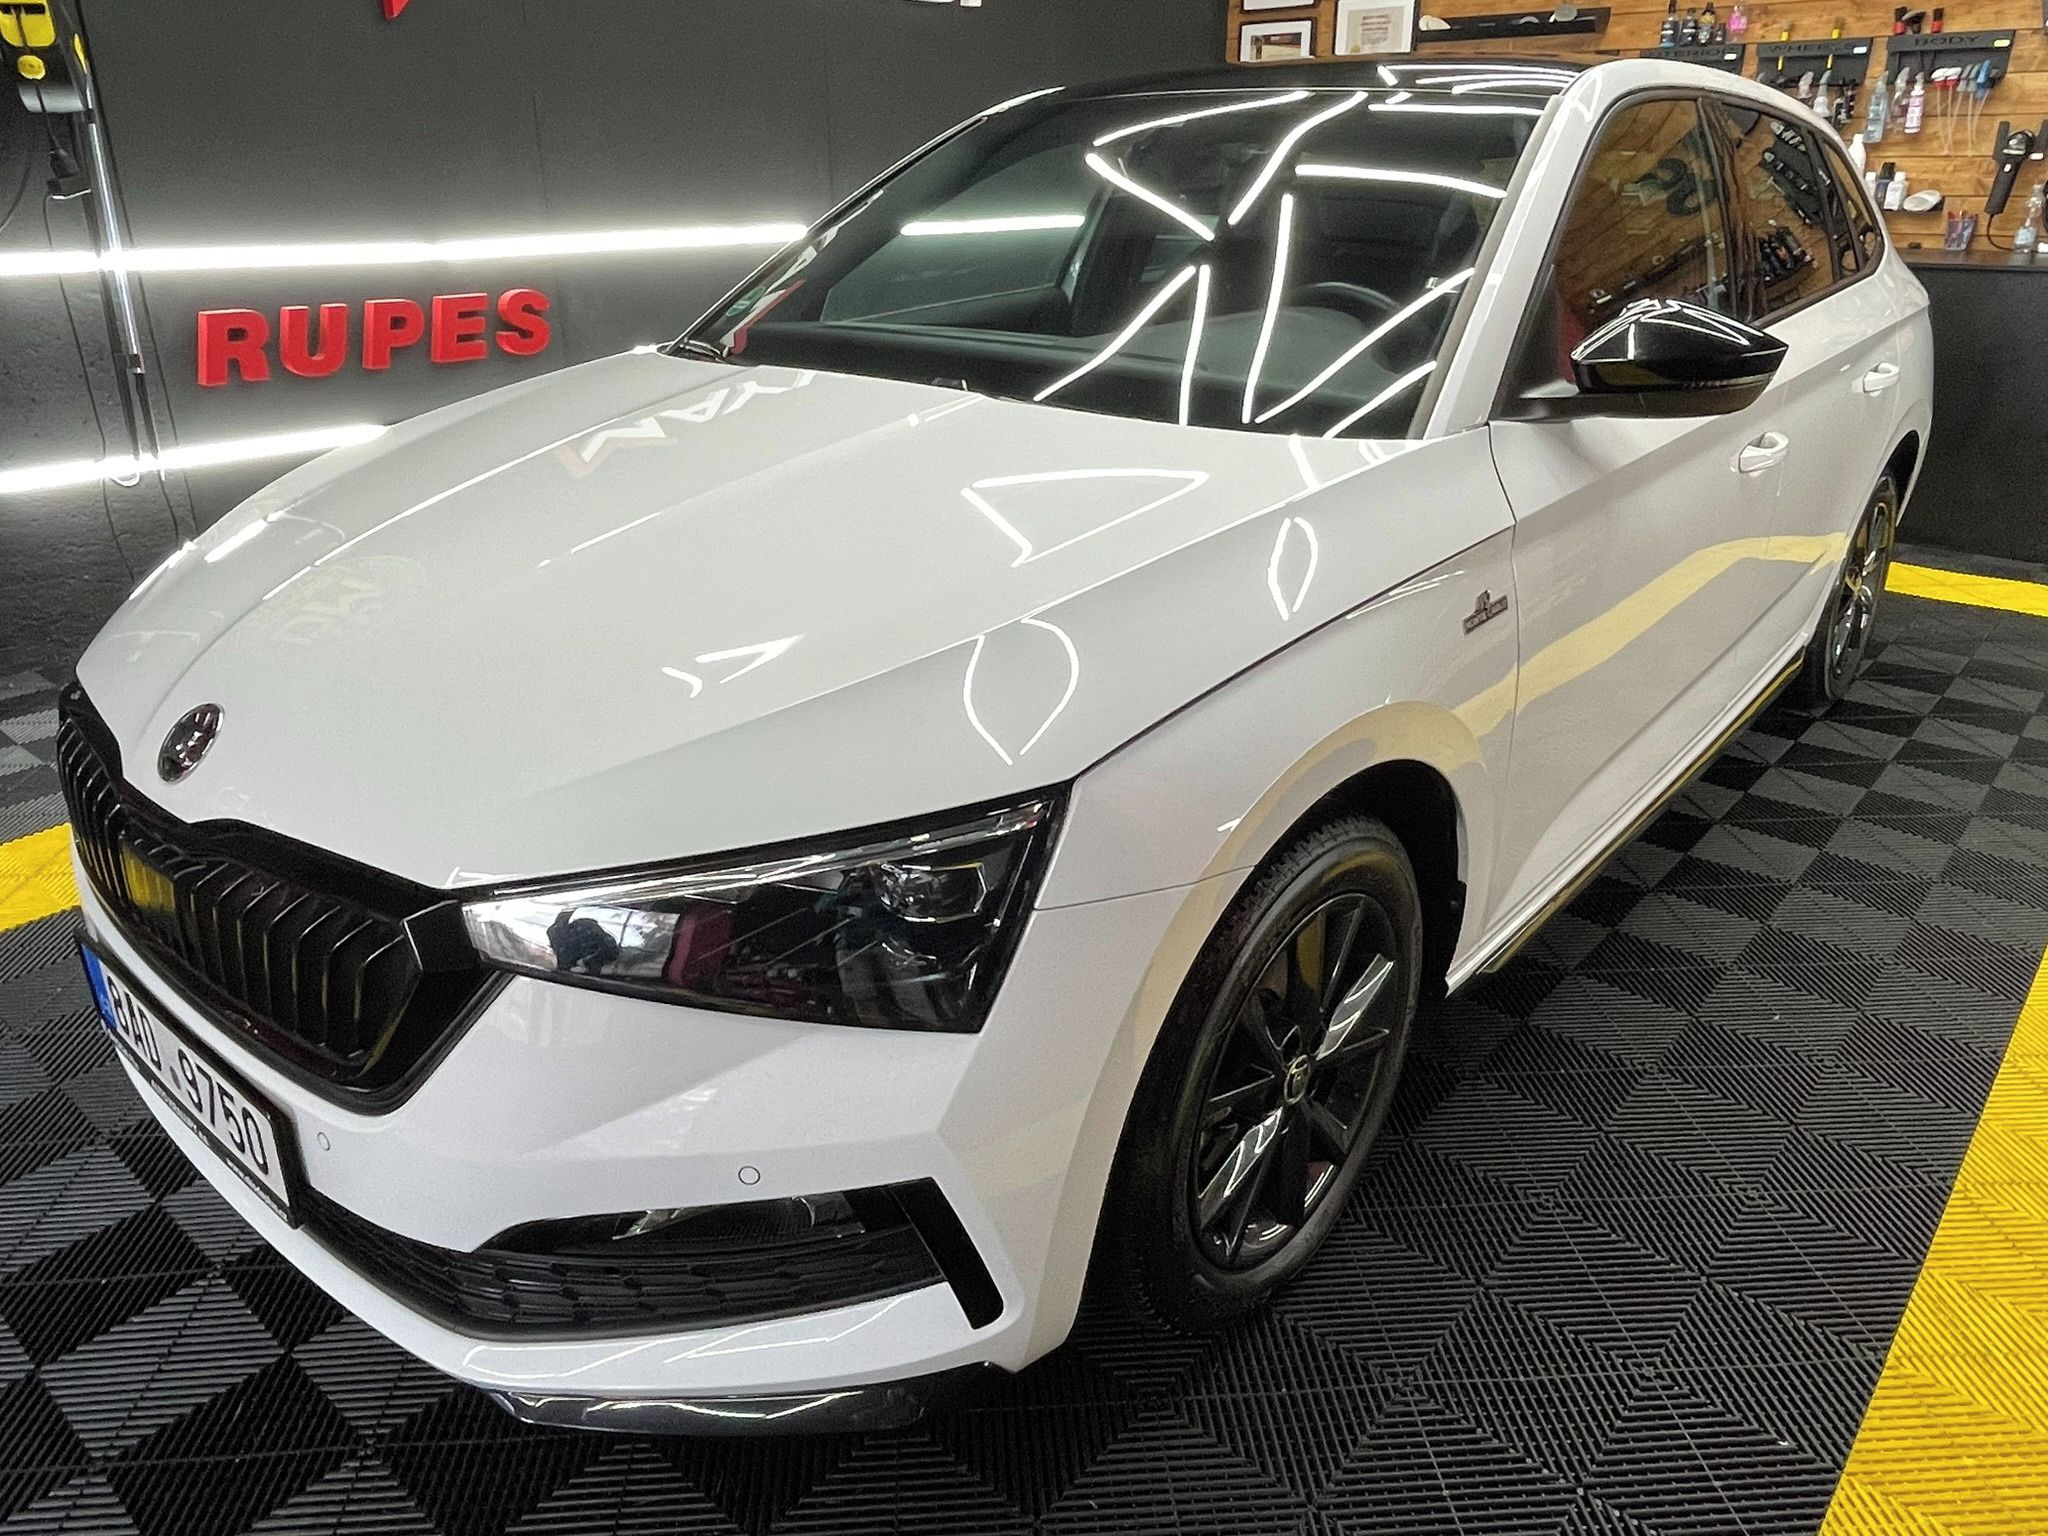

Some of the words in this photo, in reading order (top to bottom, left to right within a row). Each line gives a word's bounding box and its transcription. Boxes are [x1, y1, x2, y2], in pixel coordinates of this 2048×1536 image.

[1914, 35, 1981, 46] BODY
[197, 288, 552, 387] RUPES
[178, 1048, 269, 1175] 9750
